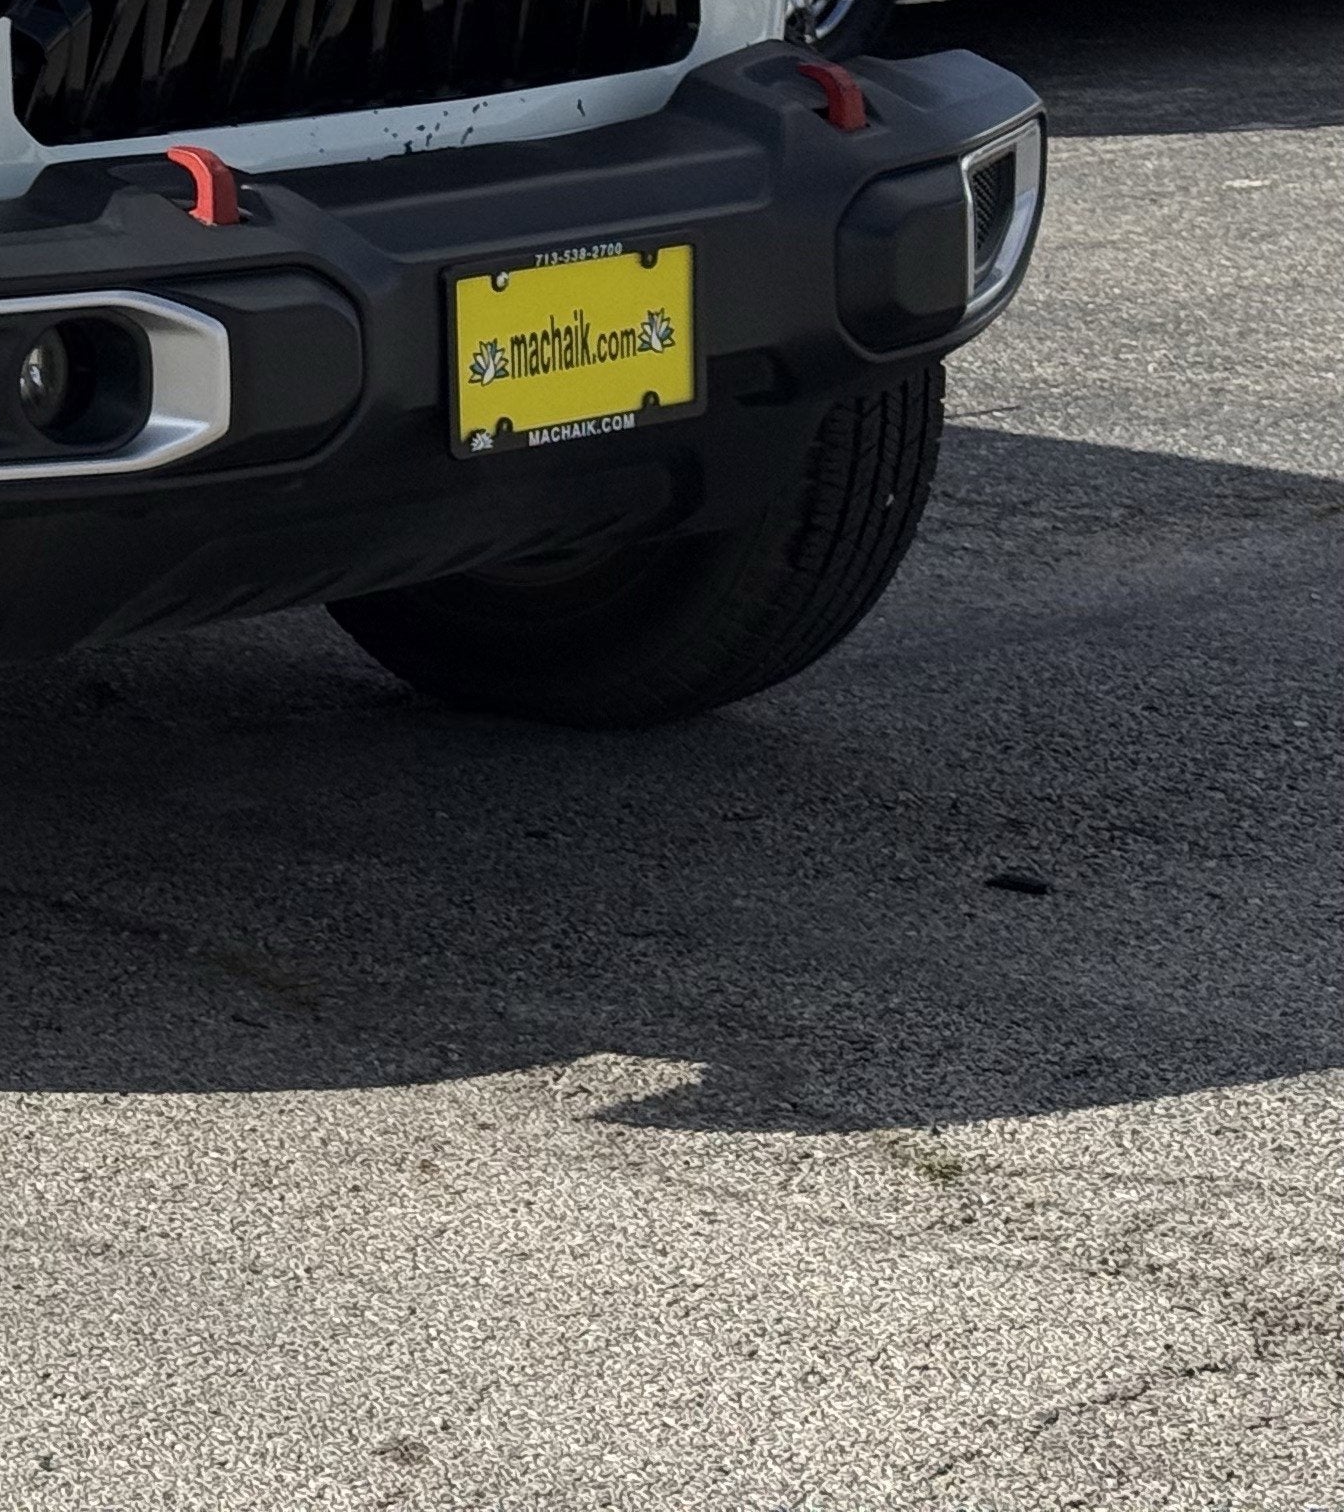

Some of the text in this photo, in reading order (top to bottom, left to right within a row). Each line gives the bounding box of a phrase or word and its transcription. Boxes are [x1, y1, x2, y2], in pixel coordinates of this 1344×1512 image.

[533, 241, 624, 267] 713-538-2700
[509, 308, 638, 379] machaik.com
[527, 413, 636, 447] MACHAIK.COM
